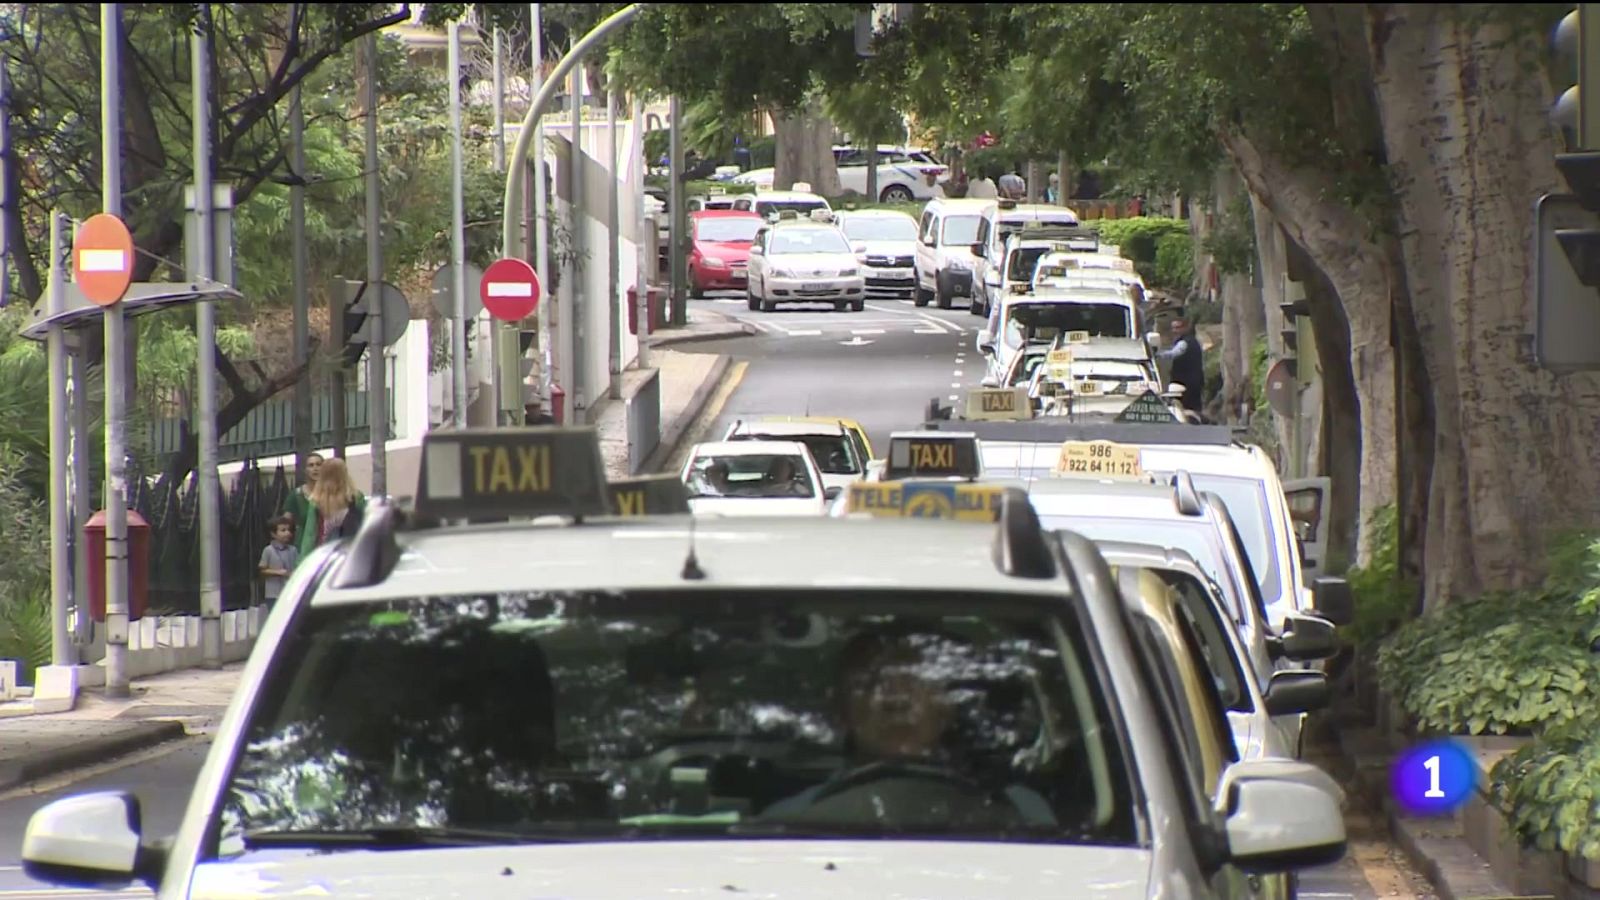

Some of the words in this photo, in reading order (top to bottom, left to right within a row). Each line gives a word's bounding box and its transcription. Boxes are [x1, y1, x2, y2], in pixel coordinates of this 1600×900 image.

[983, 393, 1014, 411] TAXI
[911, 444, 954, 468] TAXI
[1089, 444, 1112, 458] 986
[469, 446, 550, 493] TAXI
[1069, 459, 1087, 472] 922
[1090, 460, 1102, 473] 64
[1105, 461, 1116, 474] 11
[1120, 462, 1132, 475] 12
[851, 486, 900, 511] TELE
